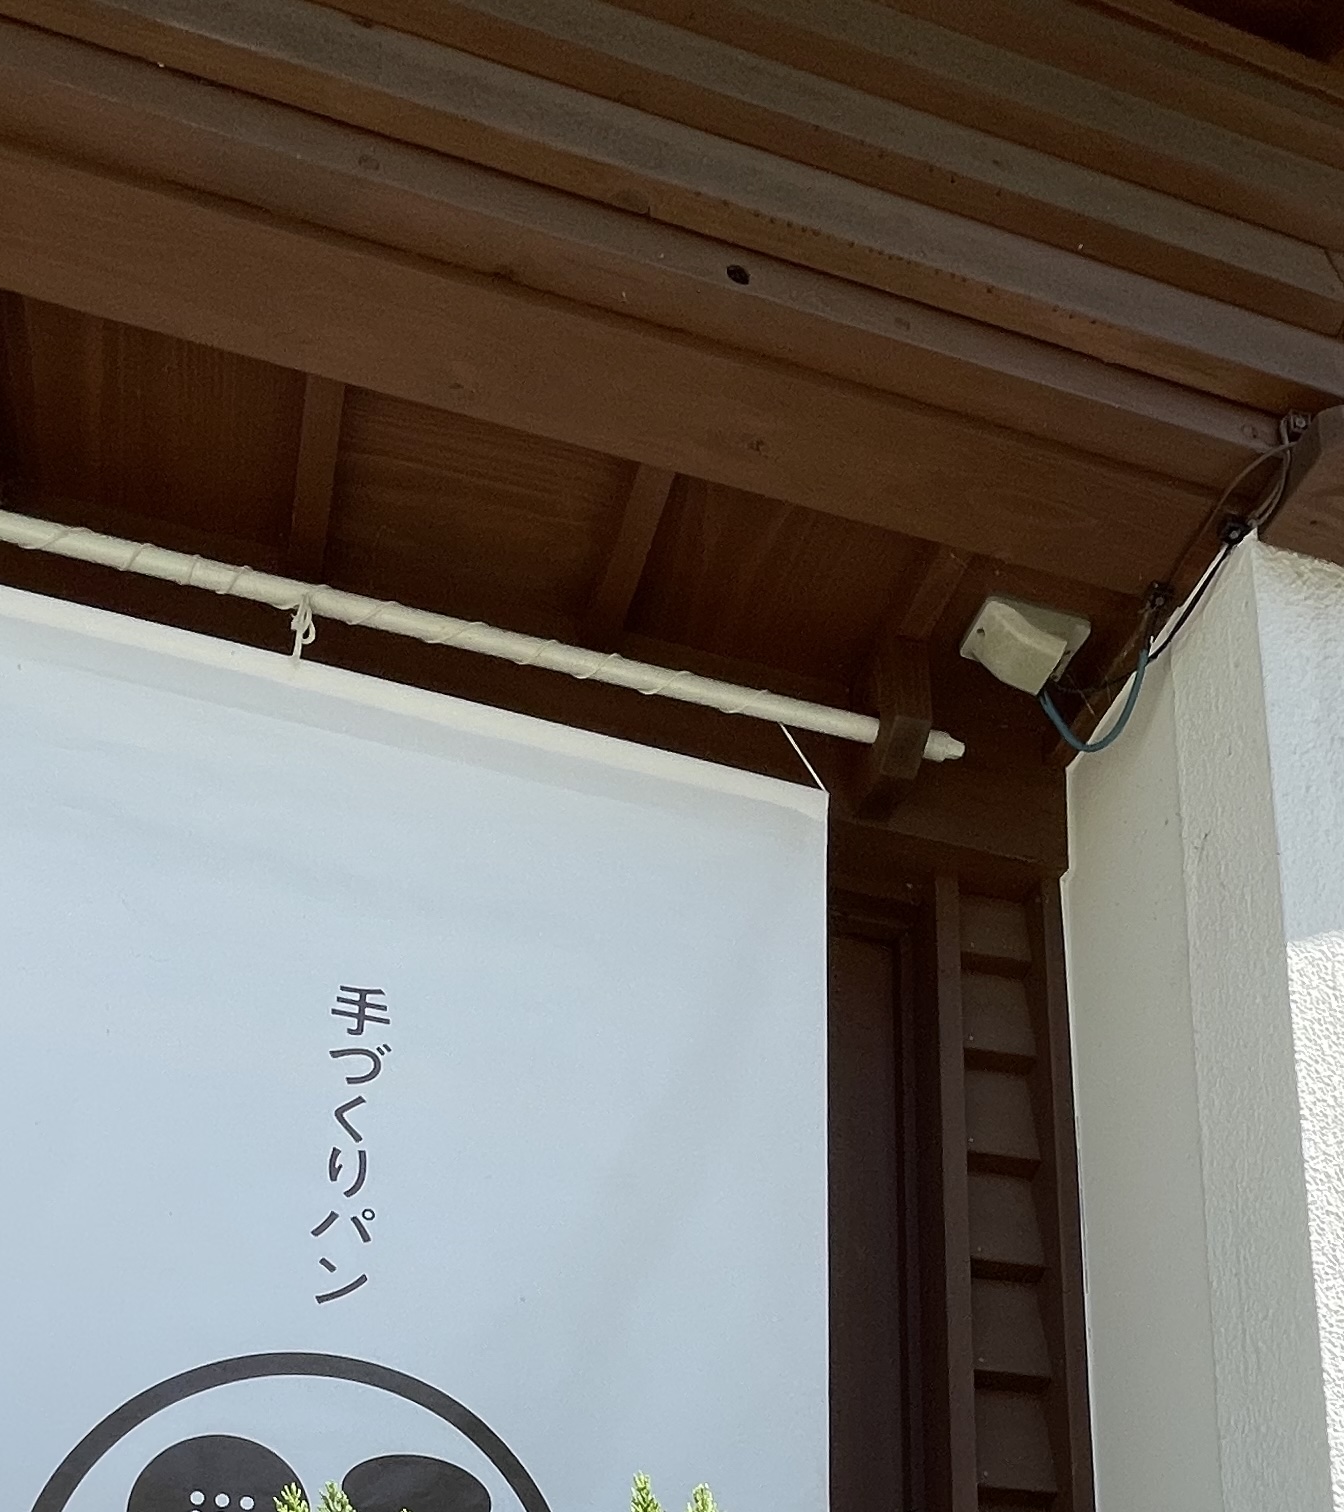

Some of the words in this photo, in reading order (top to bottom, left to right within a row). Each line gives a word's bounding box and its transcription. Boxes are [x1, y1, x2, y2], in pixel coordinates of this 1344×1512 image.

[310, 984, 392, 1304] 手づくりパン
